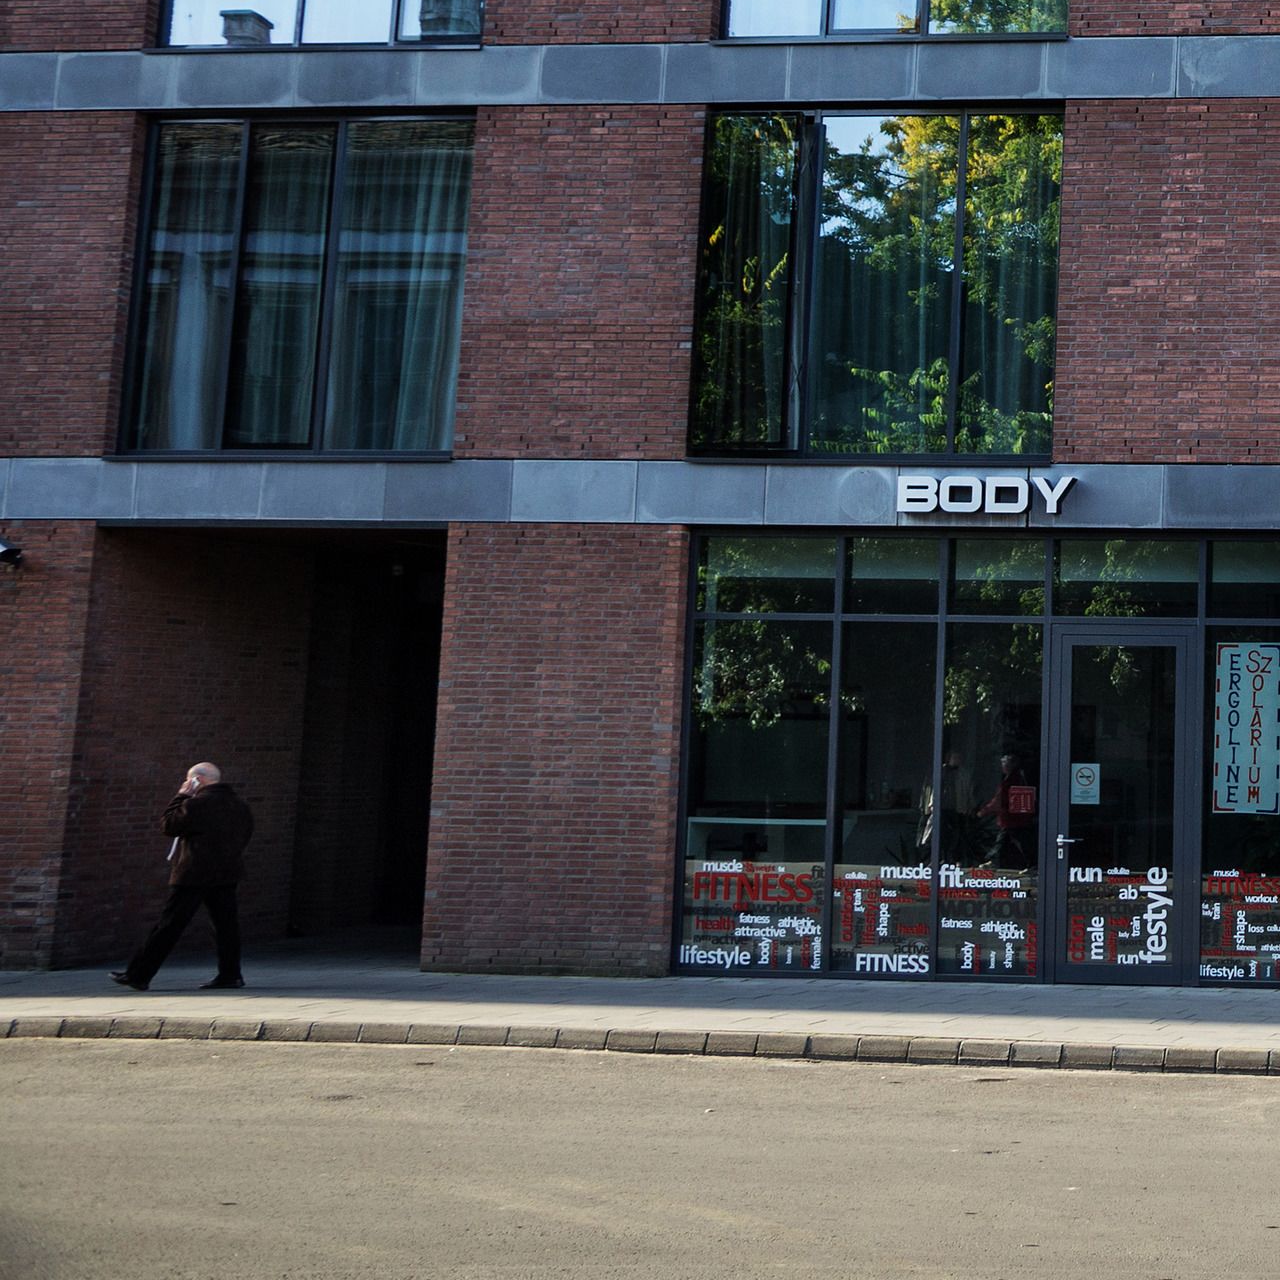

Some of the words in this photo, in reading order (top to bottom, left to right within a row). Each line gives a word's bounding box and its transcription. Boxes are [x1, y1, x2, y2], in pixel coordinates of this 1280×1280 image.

[897, 475, 1076, 514] BODY
[1226, 653, 1241, 803] ERGOLINE
[880, 862, 932, 879] muscle
[939, 863, 964, 888] fit
[1070, 867, 1103, 882] run
[694, 872, 813, 902] FITNESS
[964, 876, 1021, 888] recreation
[1207, 877, 1280, 895] FITNESS
[880, 888, 897, 897] loss
[1012, 890, 1027, 899] run
[1118, 885, 1138, 900] ab
[1245, 893, 1278, 903] workout
[695, 916, 735, 931] health
[739, 913, 770, 924] fatness
[778, 916, 815, 928] athletic
[876, 902, 891, 937] shape
[941, 917, 973, 928] fatness
[980, 920, 1018, 932] athletic
[734, 925, 786, 937] attractive
[795, 925, 821, 937] sport
[998, 928, 1025, 941] sport
[1233, 910, 1247, 944] shape
[1248, 924, 1264, 933] loss
[1087, 916, 1104, 960] male
[680, 944, 751, 968] lifestyle
[758, 937, 773, 965] body
[811, 936, 821, 969] female
[961, 941, 976, 969] body
[1003, 942, 1015, 969] shape
[855, 953, 930, 974] FITNESS
[1118, 954, 1139, 964] run
[1199, 964, 1245, 980] lifestyle
